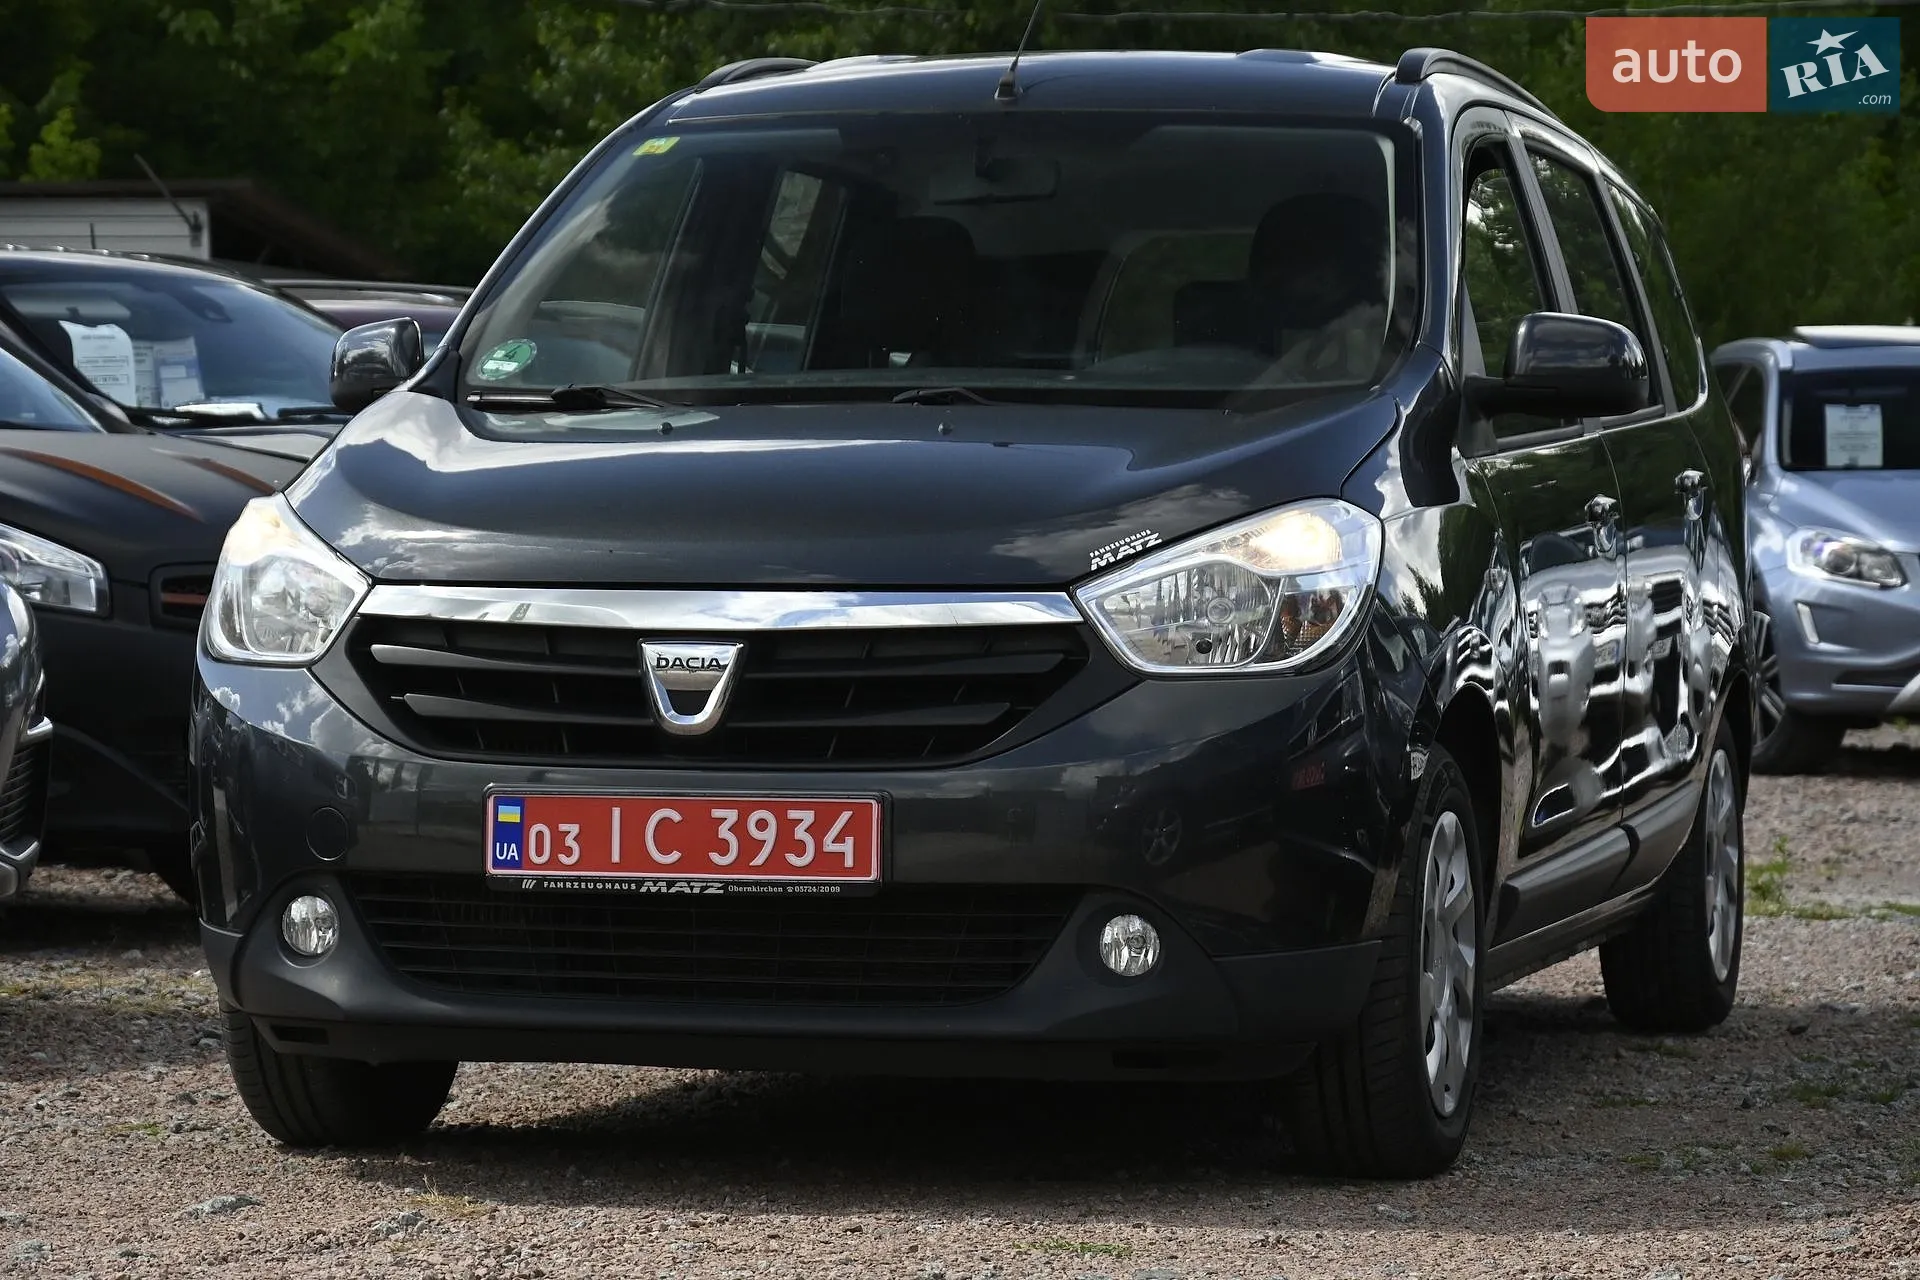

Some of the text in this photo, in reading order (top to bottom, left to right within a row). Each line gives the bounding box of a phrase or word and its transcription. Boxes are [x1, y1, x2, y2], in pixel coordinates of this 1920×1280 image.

[1090, 532, 1163, 571] MATZ
[656, 657, 721, 669] DACIA
[528, 807, 856, 868] 03 IC 3934
[496, 842, 519, 861] UA
[543, 881, 637, 890] FAHRZEUGHAUS
[639, 881, 725, 894] MATZ
[728, 885, 783, 893] Obernkirchen
